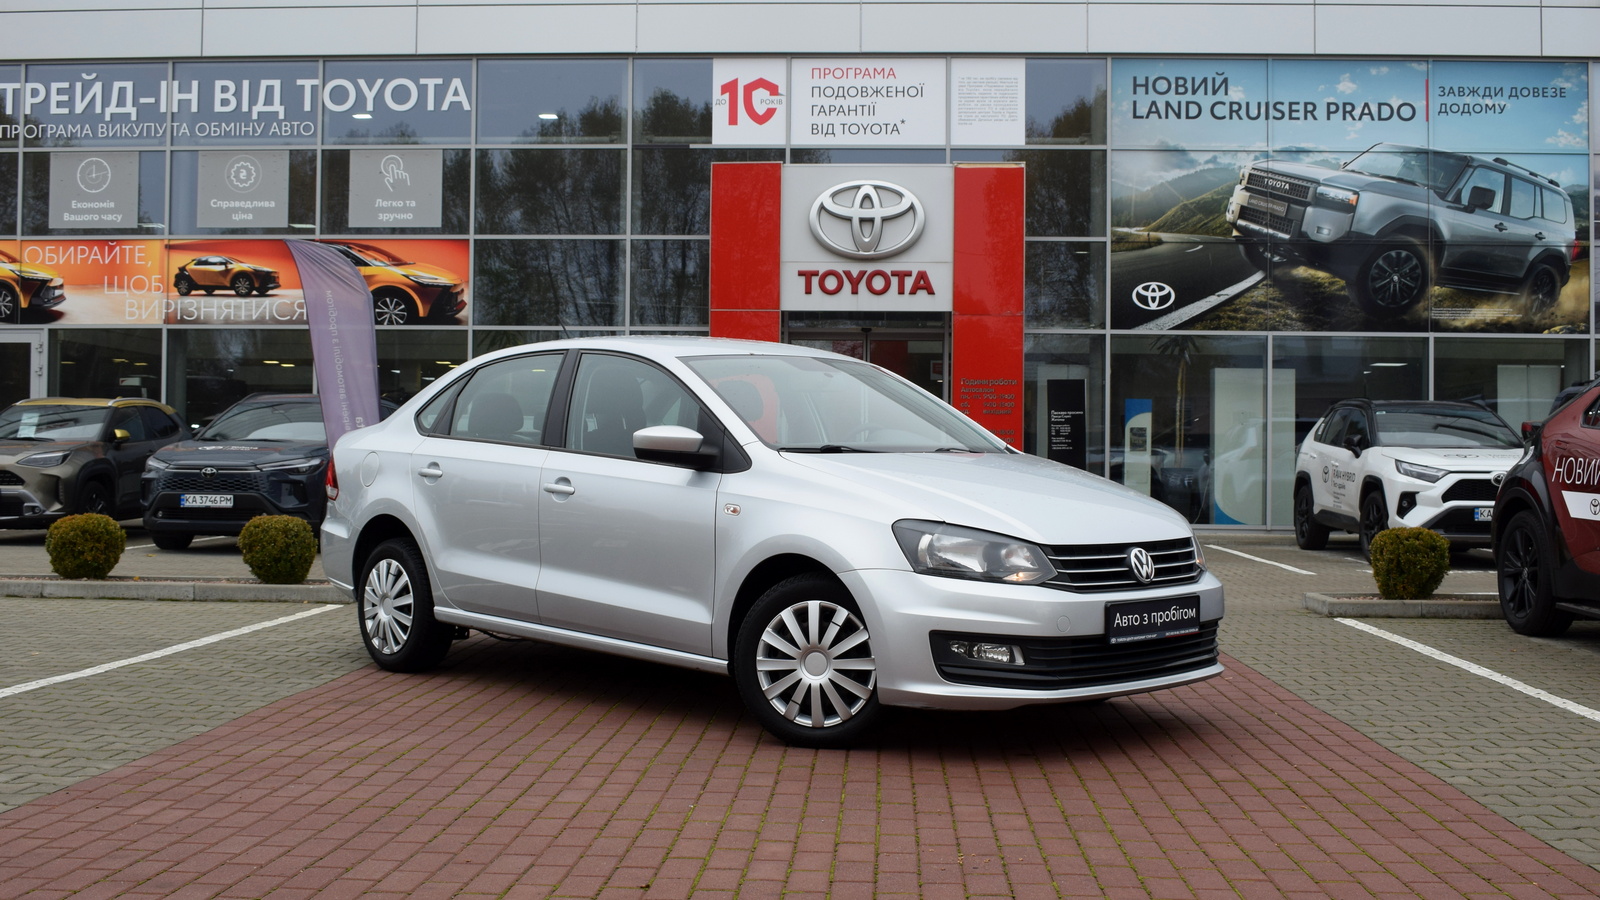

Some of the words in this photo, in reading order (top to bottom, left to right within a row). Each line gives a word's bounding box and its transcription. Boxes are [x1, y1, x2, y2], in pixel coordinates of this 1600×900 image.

[811, 67, 897, 80] ПРОГРАМА
[811, 83, 925, 100] ПОДОВЖЕНОЇ
[1132, 72, 1229, 96] НОВИЙ
[0, 73, 198, 121] ТРЕЙД-ІН
[214, 79, 285, 120] ВІД
[296, 77, 472, 112] TOYOTA
[1438, 86, 1504, 100] ЗАВЖДИ
[1508, 86, 1567, 100] ДОВЕЗЕ
[811, 101, 877, 117] ГАРАНТІЇ
[1132, 100, 1203, 120] LAND
[1210, 100, 1318, 121] CRUISER
[1326, 101, 1417, 122] PRADO
[1437, 103, 1507, 116] ДОДОМУ
[0, 124, 93, 139] ПРОГРАМА
[98, 122, 167, 138] ВИКУПУ
[171, 122, 190, 137] ТА
[195, 122, 265, 136] ОБМІНУ
[269, 121, 315, 136] АВТО
[811, 123, 836, 137] ВІД
[1264, 178, 1290, 190] TOYOTA
[71, 200, 115, 209] Економія
[210, 199, 275, 210] Справедлива
[375, 199, 403, 209] Легко
[405, 200, 416, 208] та
[63, 212, 99, 221] Вашого
[101, 213, 123, 223] часу
[232, 211, 253, 221] ціна
[377, 212, 413, 221] зручно
[24, 241, 153, 267] ОБИРАЙТЕ,
[103, 275, 165, 296] ЩОБ
[798, 269, 936, 295] TOYOTA
[124, 299, 307, 321] ВИРІЗНЯТИСЯ
[1114, 612, 1140, 628] Авто
[1142, 613, 1149, 625] з
[1151, 605, 1196, 627] пробігом
